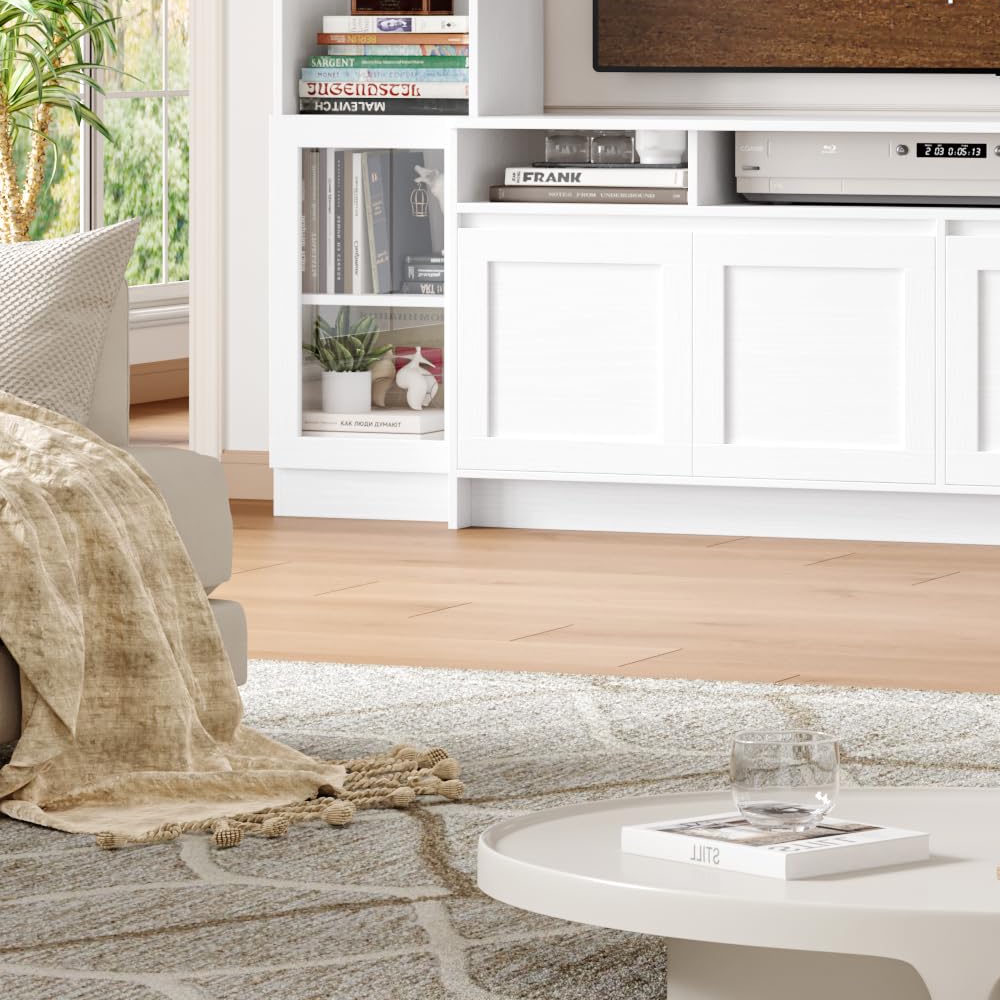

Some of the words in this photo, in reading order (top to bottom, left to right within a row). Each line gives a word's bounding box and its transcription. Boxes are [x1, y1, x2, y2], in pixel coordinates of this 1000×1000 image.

[311, 58, 355, 68] SARGENT
[306, 82, 421, 97] JUGENDSTIL
[314, 101, 386, 112] MALEVITCH
[924, 147, 932, 156] 2
[934, 147, 945, 156] 03
[522, 172, 582, 183] FRANK
